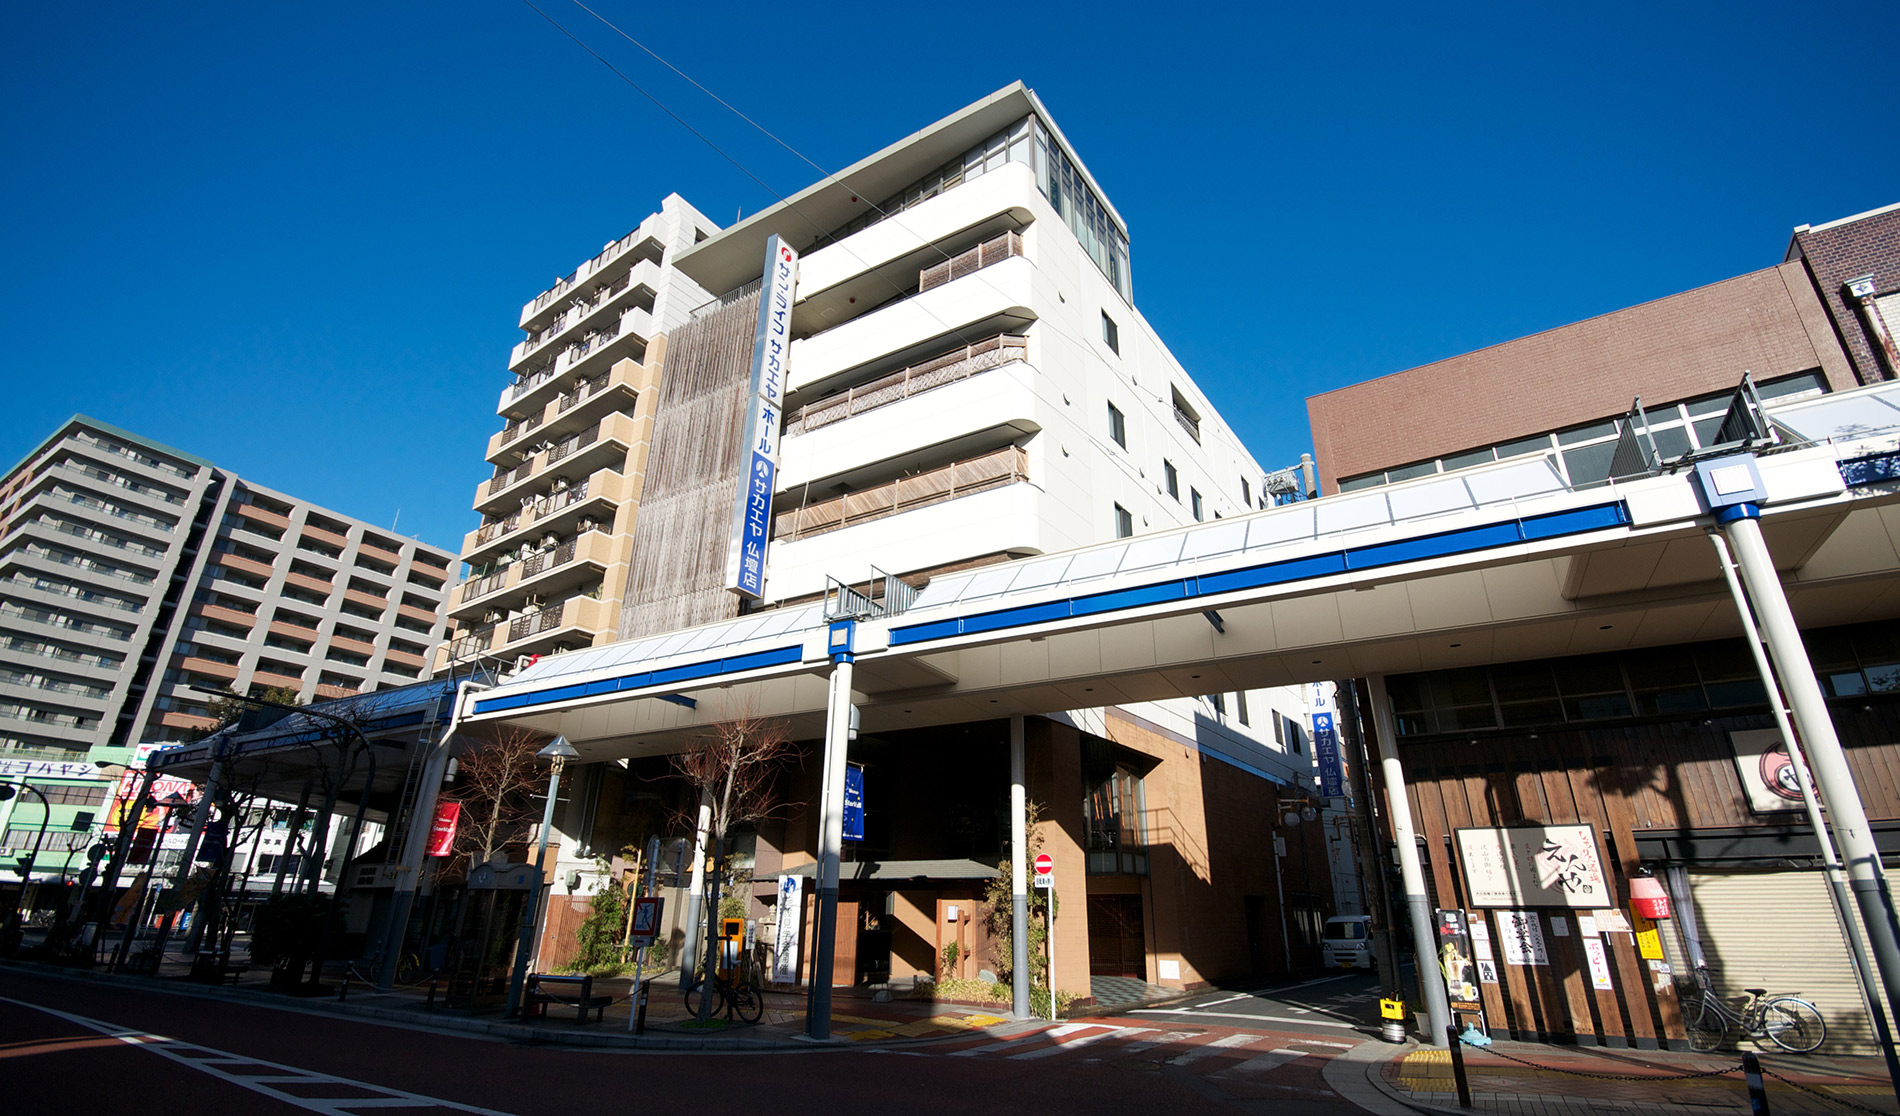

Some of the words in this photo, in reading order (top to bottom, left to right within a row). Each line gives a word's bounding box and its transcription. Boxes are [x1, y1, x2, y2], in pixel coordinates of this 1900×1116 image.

[749, 478, 767, 537] サカエヤ
[743, 541, 759, 590] 仏壇店
[1318, 728, 1335, 764] サカエヤ
[15, 761, 94, 776] コバヤシ
[1325, 768, 1339, 795] 仏壇店
[1542, 838, 1587, 894] えんや
[1511, 914, 1533, 954] 御宴会
[1589, 943, 1602, 973] ホッピー
